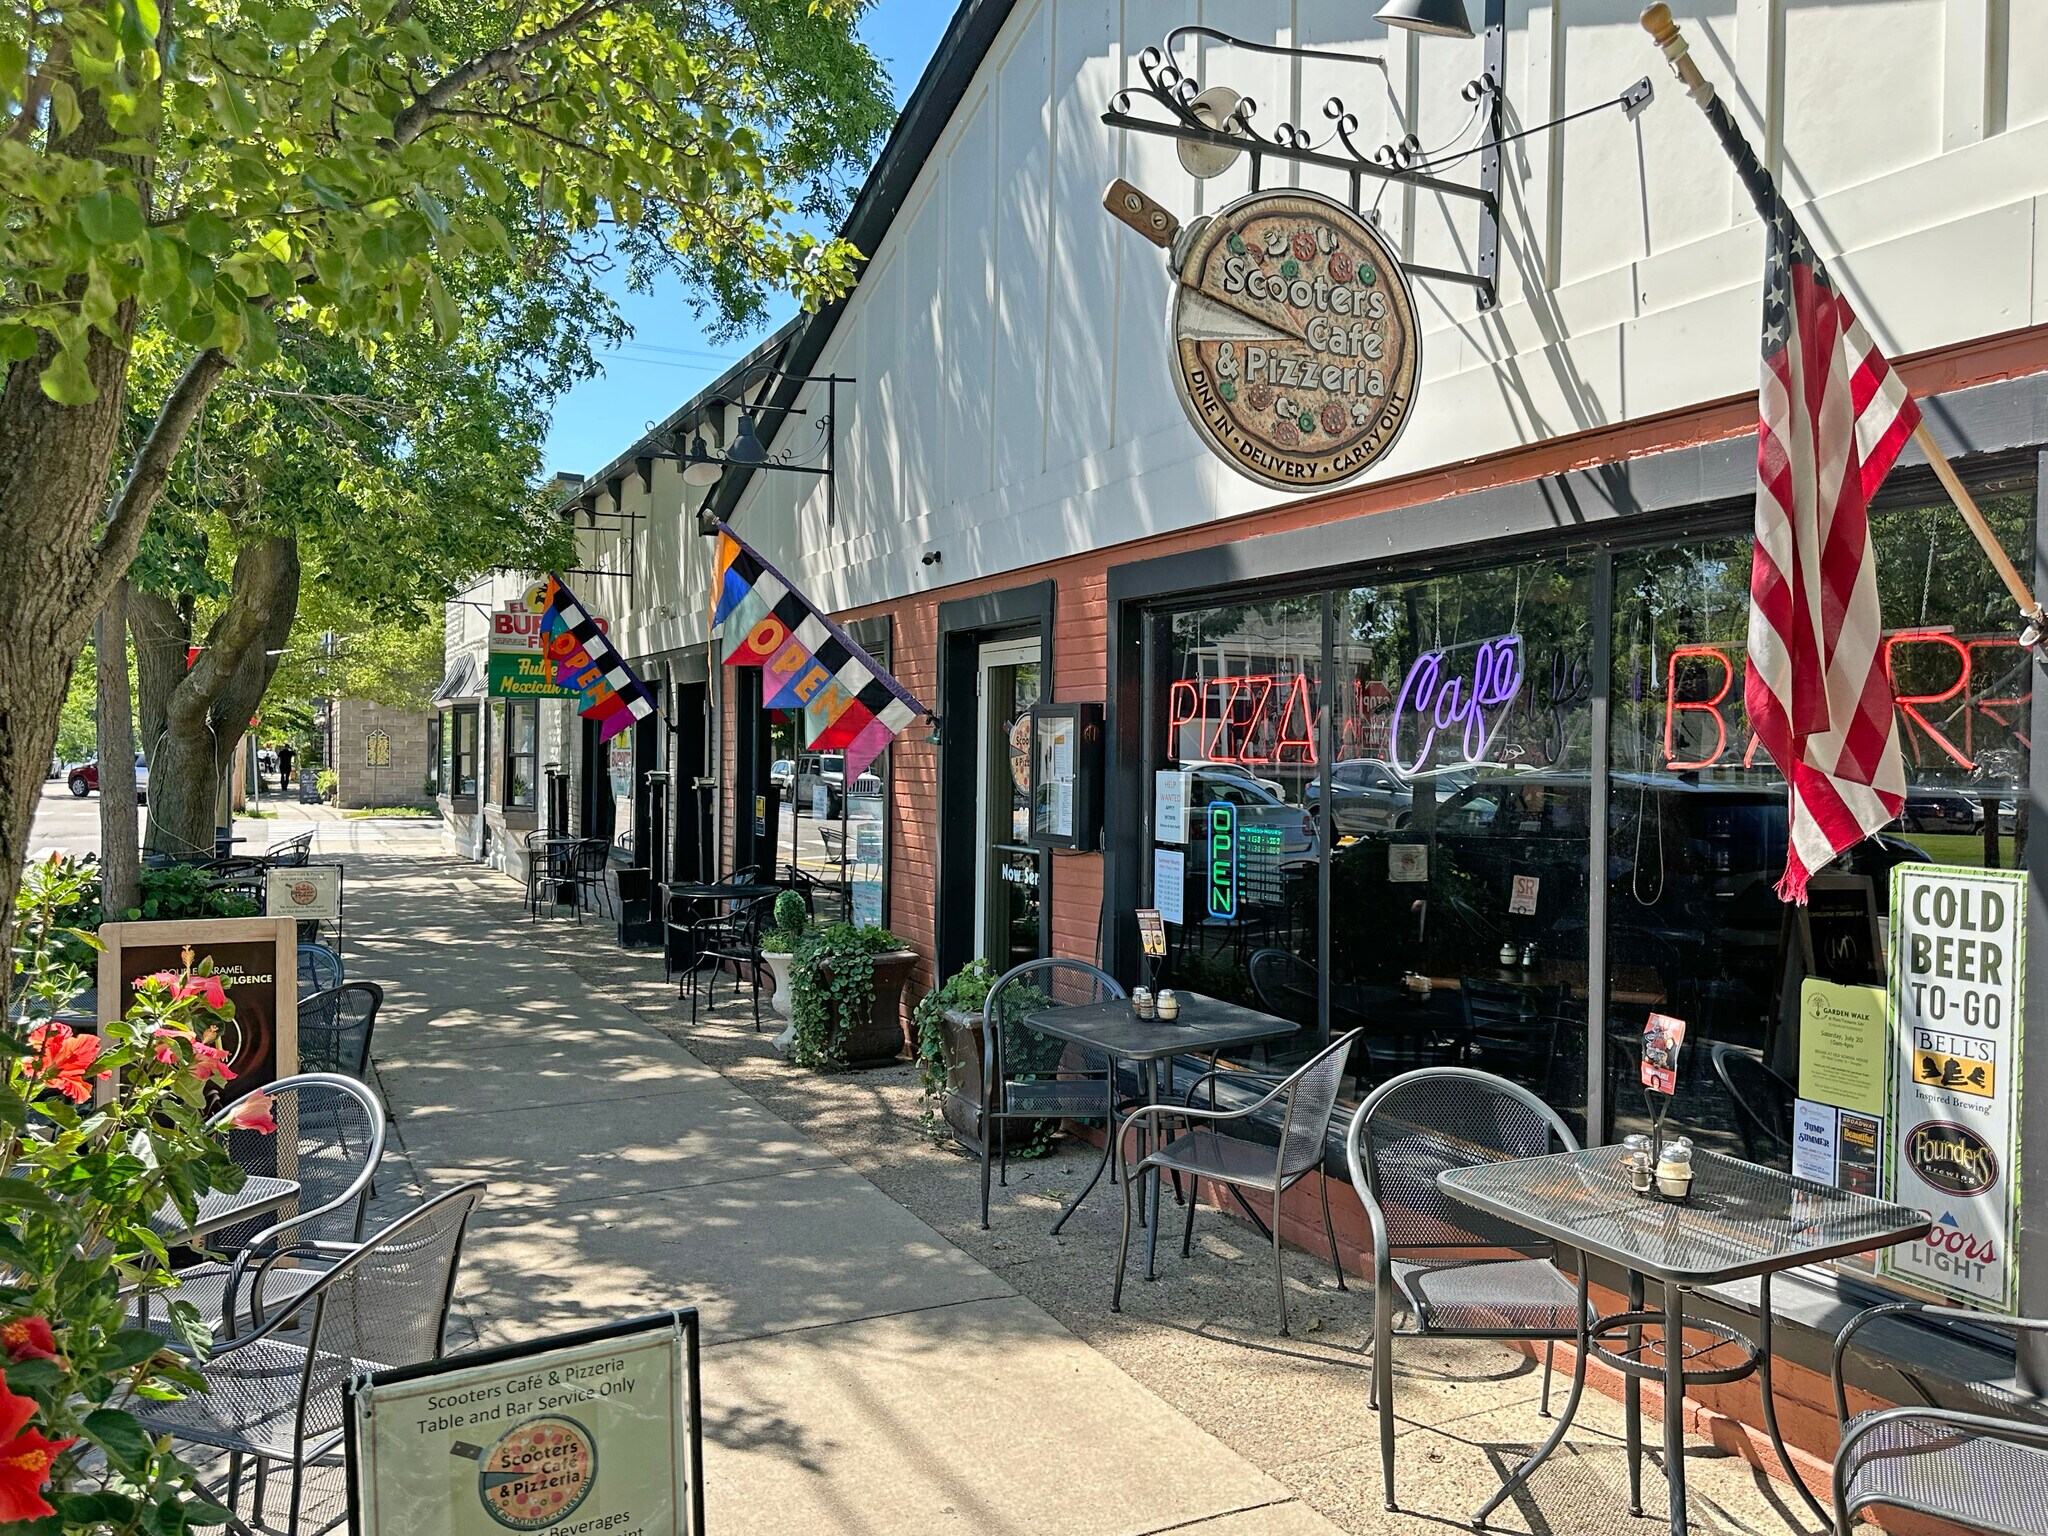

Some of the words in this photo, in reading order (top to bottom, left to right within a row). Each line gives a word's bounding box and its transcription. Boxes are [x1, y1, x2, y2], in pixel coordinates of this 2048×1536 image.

[1224, 256, 1386, 320] Scooters
[1306, 316, 1385, 359] Café
[1217, 342, 1240, 380] &
[1247, 346, 1386, 397] Pizzeria
[1191, 371, 1220, 416] DINE
[1214, 414, 1236, 438] IN
[1240, 439, 1318, 479] DELIVERY
[1332, 433, 1382, 472] CARRY
[1380, 391, 1405, 431] OUT
[509, 602, 528, 613] EL
[552, 633, 616, 707] OPEN
[748, 618, 855, 729] OPEN
[500, 676, 561, 696] Mexican
[1390, 636, 1522, 776] Café
[1663, 630, 1978, 772] BR
[1168, 674, 1319, 765] PIZZA
[1016, 736, 1029, 746] Scoo
[1160, 793, 1182, 803] WANTED
[1164, 780, 1177, 789] HELP
[1001, 863, 1021, 883] Now
[1213, 809, 1231, 912] OPEN
[1912, 884, 2005, 933] COLD
[209, 965, 244, 975] ARAMEL
[1911, 933, 2003, 986] BEER
[1823, 1007, 1849, 1018] GARDEN
[1851, 1012, 1870, 1022] WALK
[1911, 982, 2001, 1030] TO-GO
[1820, 1030, 1844, 1041] Saturday,
[1844, 1035, 1855, 1043] July
[1855, 1036, 1864, 1044] 20
[1830, 1039, 1854, 1049] 10am-4pm
[1920, 1031, 1990, 1061] BELL'S
[1916, 1089, 1950, 1105] Inspired
[1953, 1097, 1990, 1116] Brewing
[1804, 1121, 1825, 1134] JUMP
[1842, 1116, 1877, 1130] BROADWAY
[1844, 1128, 1874, 1143] Beautiful
[1798, 1132, 1830, 1148] SUMMER
[1925, 1164, 1975, 1185] Brewing
[1910, 1209, 1997, 1264] oors
[1912, 1243, 1986, 1283] LIGHT
[428, 1386, 501, 1411] Scooters
[506, 1373, 543, 1394] Café
[548, 1370, 561, 1386] &
[565, 1358, 625, 1382] Pizzeria
[417, 1414, 464, 1434] Table
[469, 1405, 501, 1424] and
[506, 1402, 533, 1417] Bar
[538, 1388, 596, 1411] Service
[600, 1377, 635, 1397] Only
[501, 1442, 578, 1469] Scooters
[541, 1454, 578, 1474] Café
[500, 1485, 510, 1498] &
[513, 1472, 580, 1496] Pizzeria
[513, 1514, 551, 1526] DELIVERY
[556, 1494, 581, 1516] CARRY
[579, 1477, 592, 1493] OUT
[550, 1511, 630, 1536] Beverages
